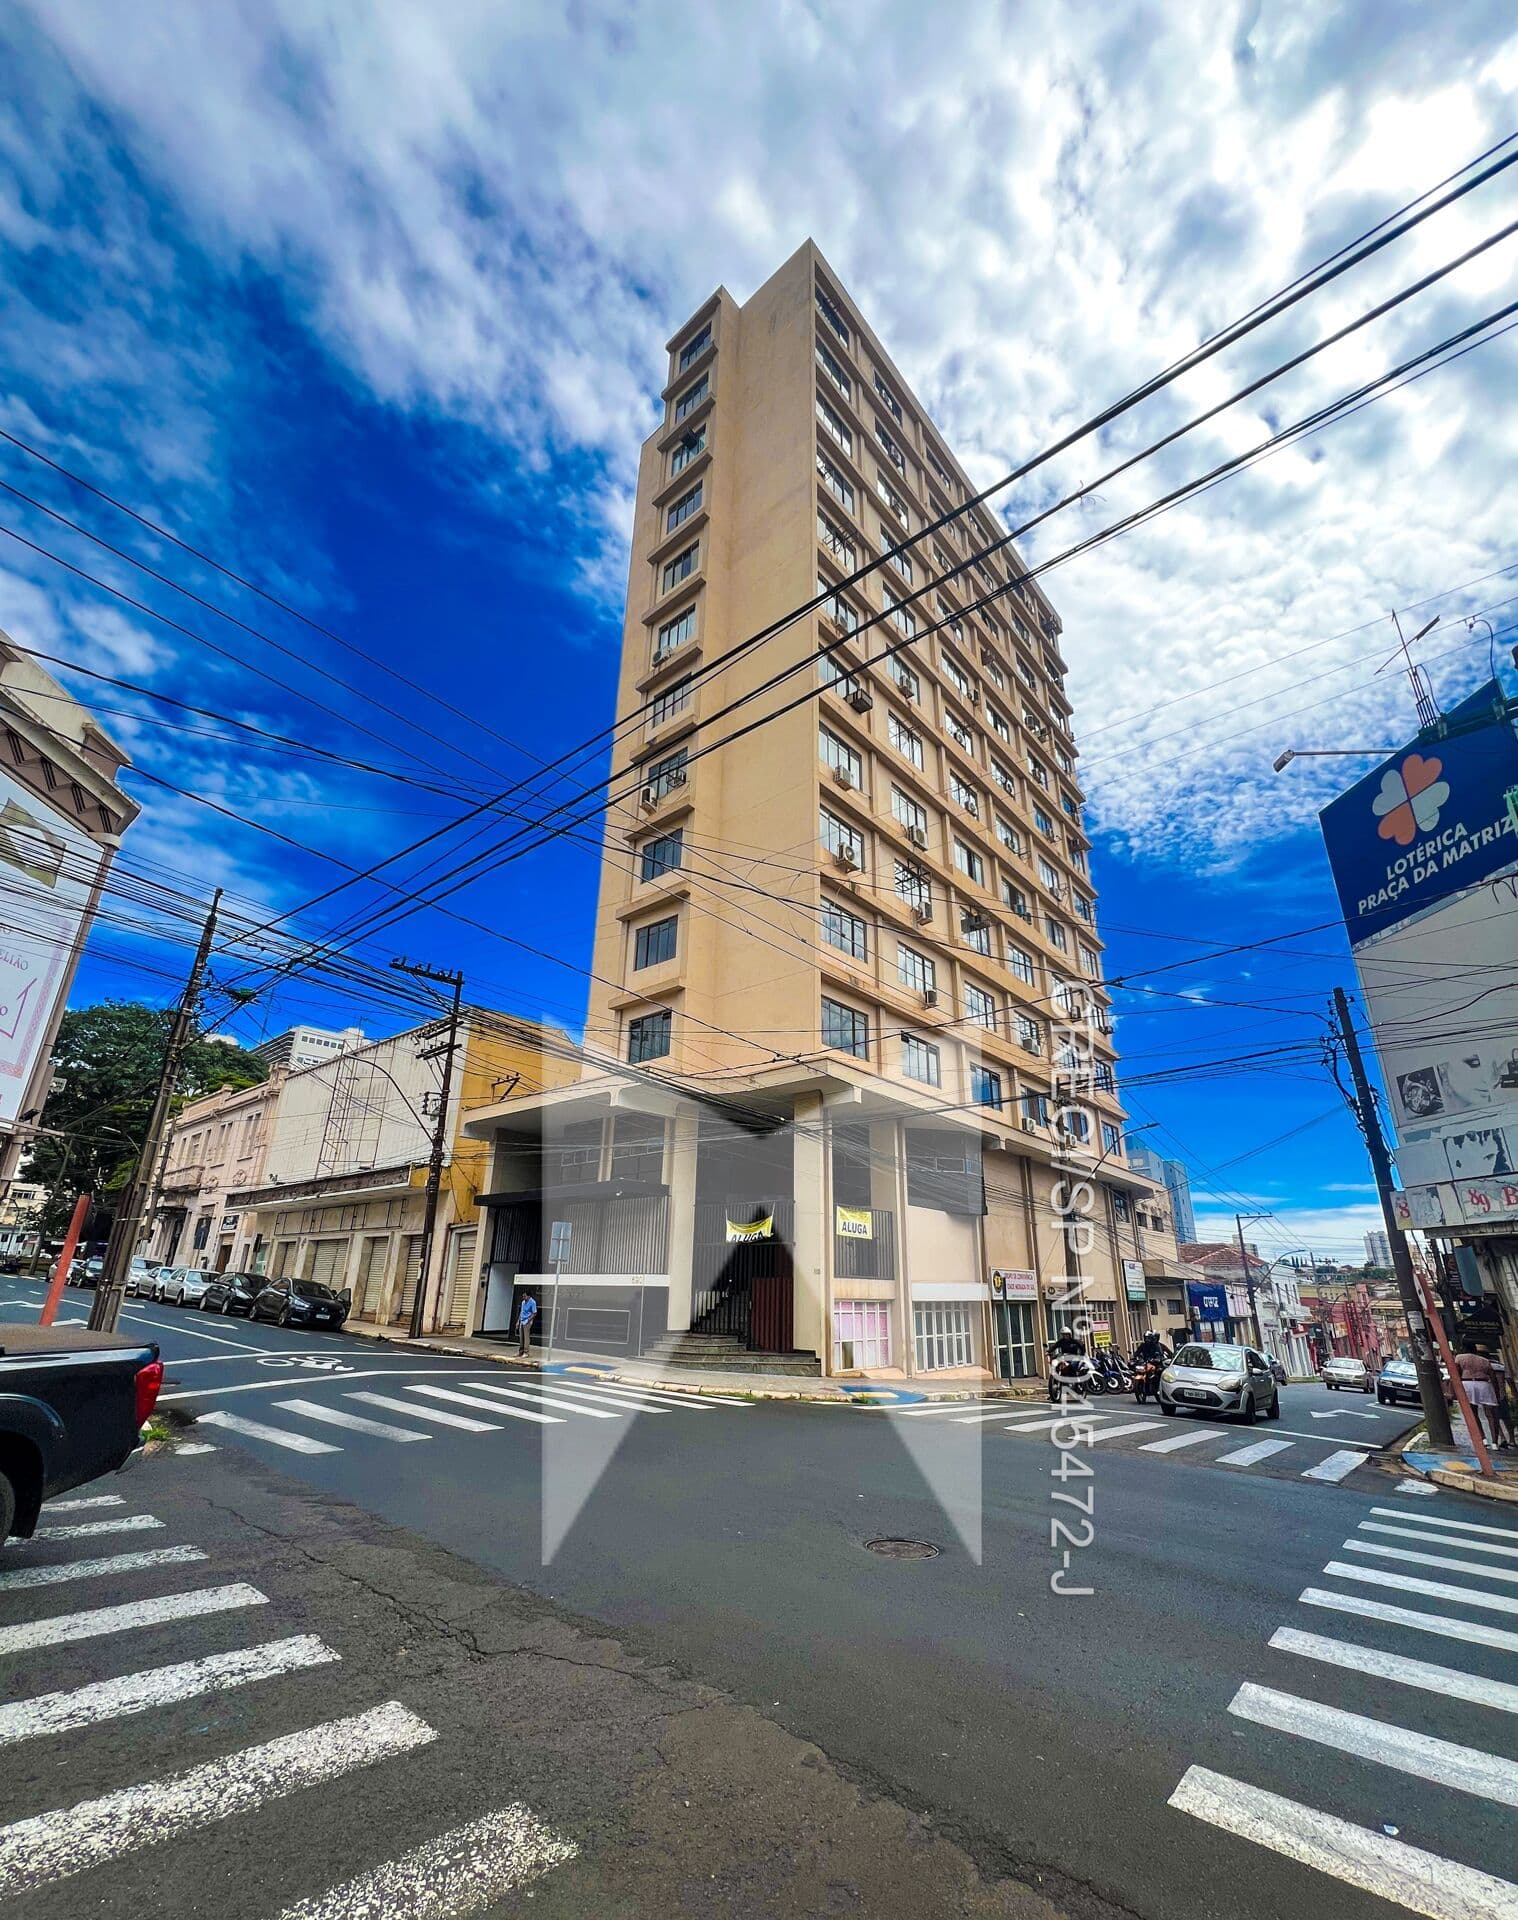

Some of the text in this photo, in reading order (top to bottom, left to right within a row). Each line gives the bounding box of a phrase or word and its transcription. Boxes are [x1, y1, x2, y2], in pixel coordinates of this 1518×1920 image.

[1357, 815, 1514, 915] PRAÇA DA MATRIZ
[1386, 822, 1468, 880] LOTÉRICA
[841, 1221, 868, 1235] ALUGA
